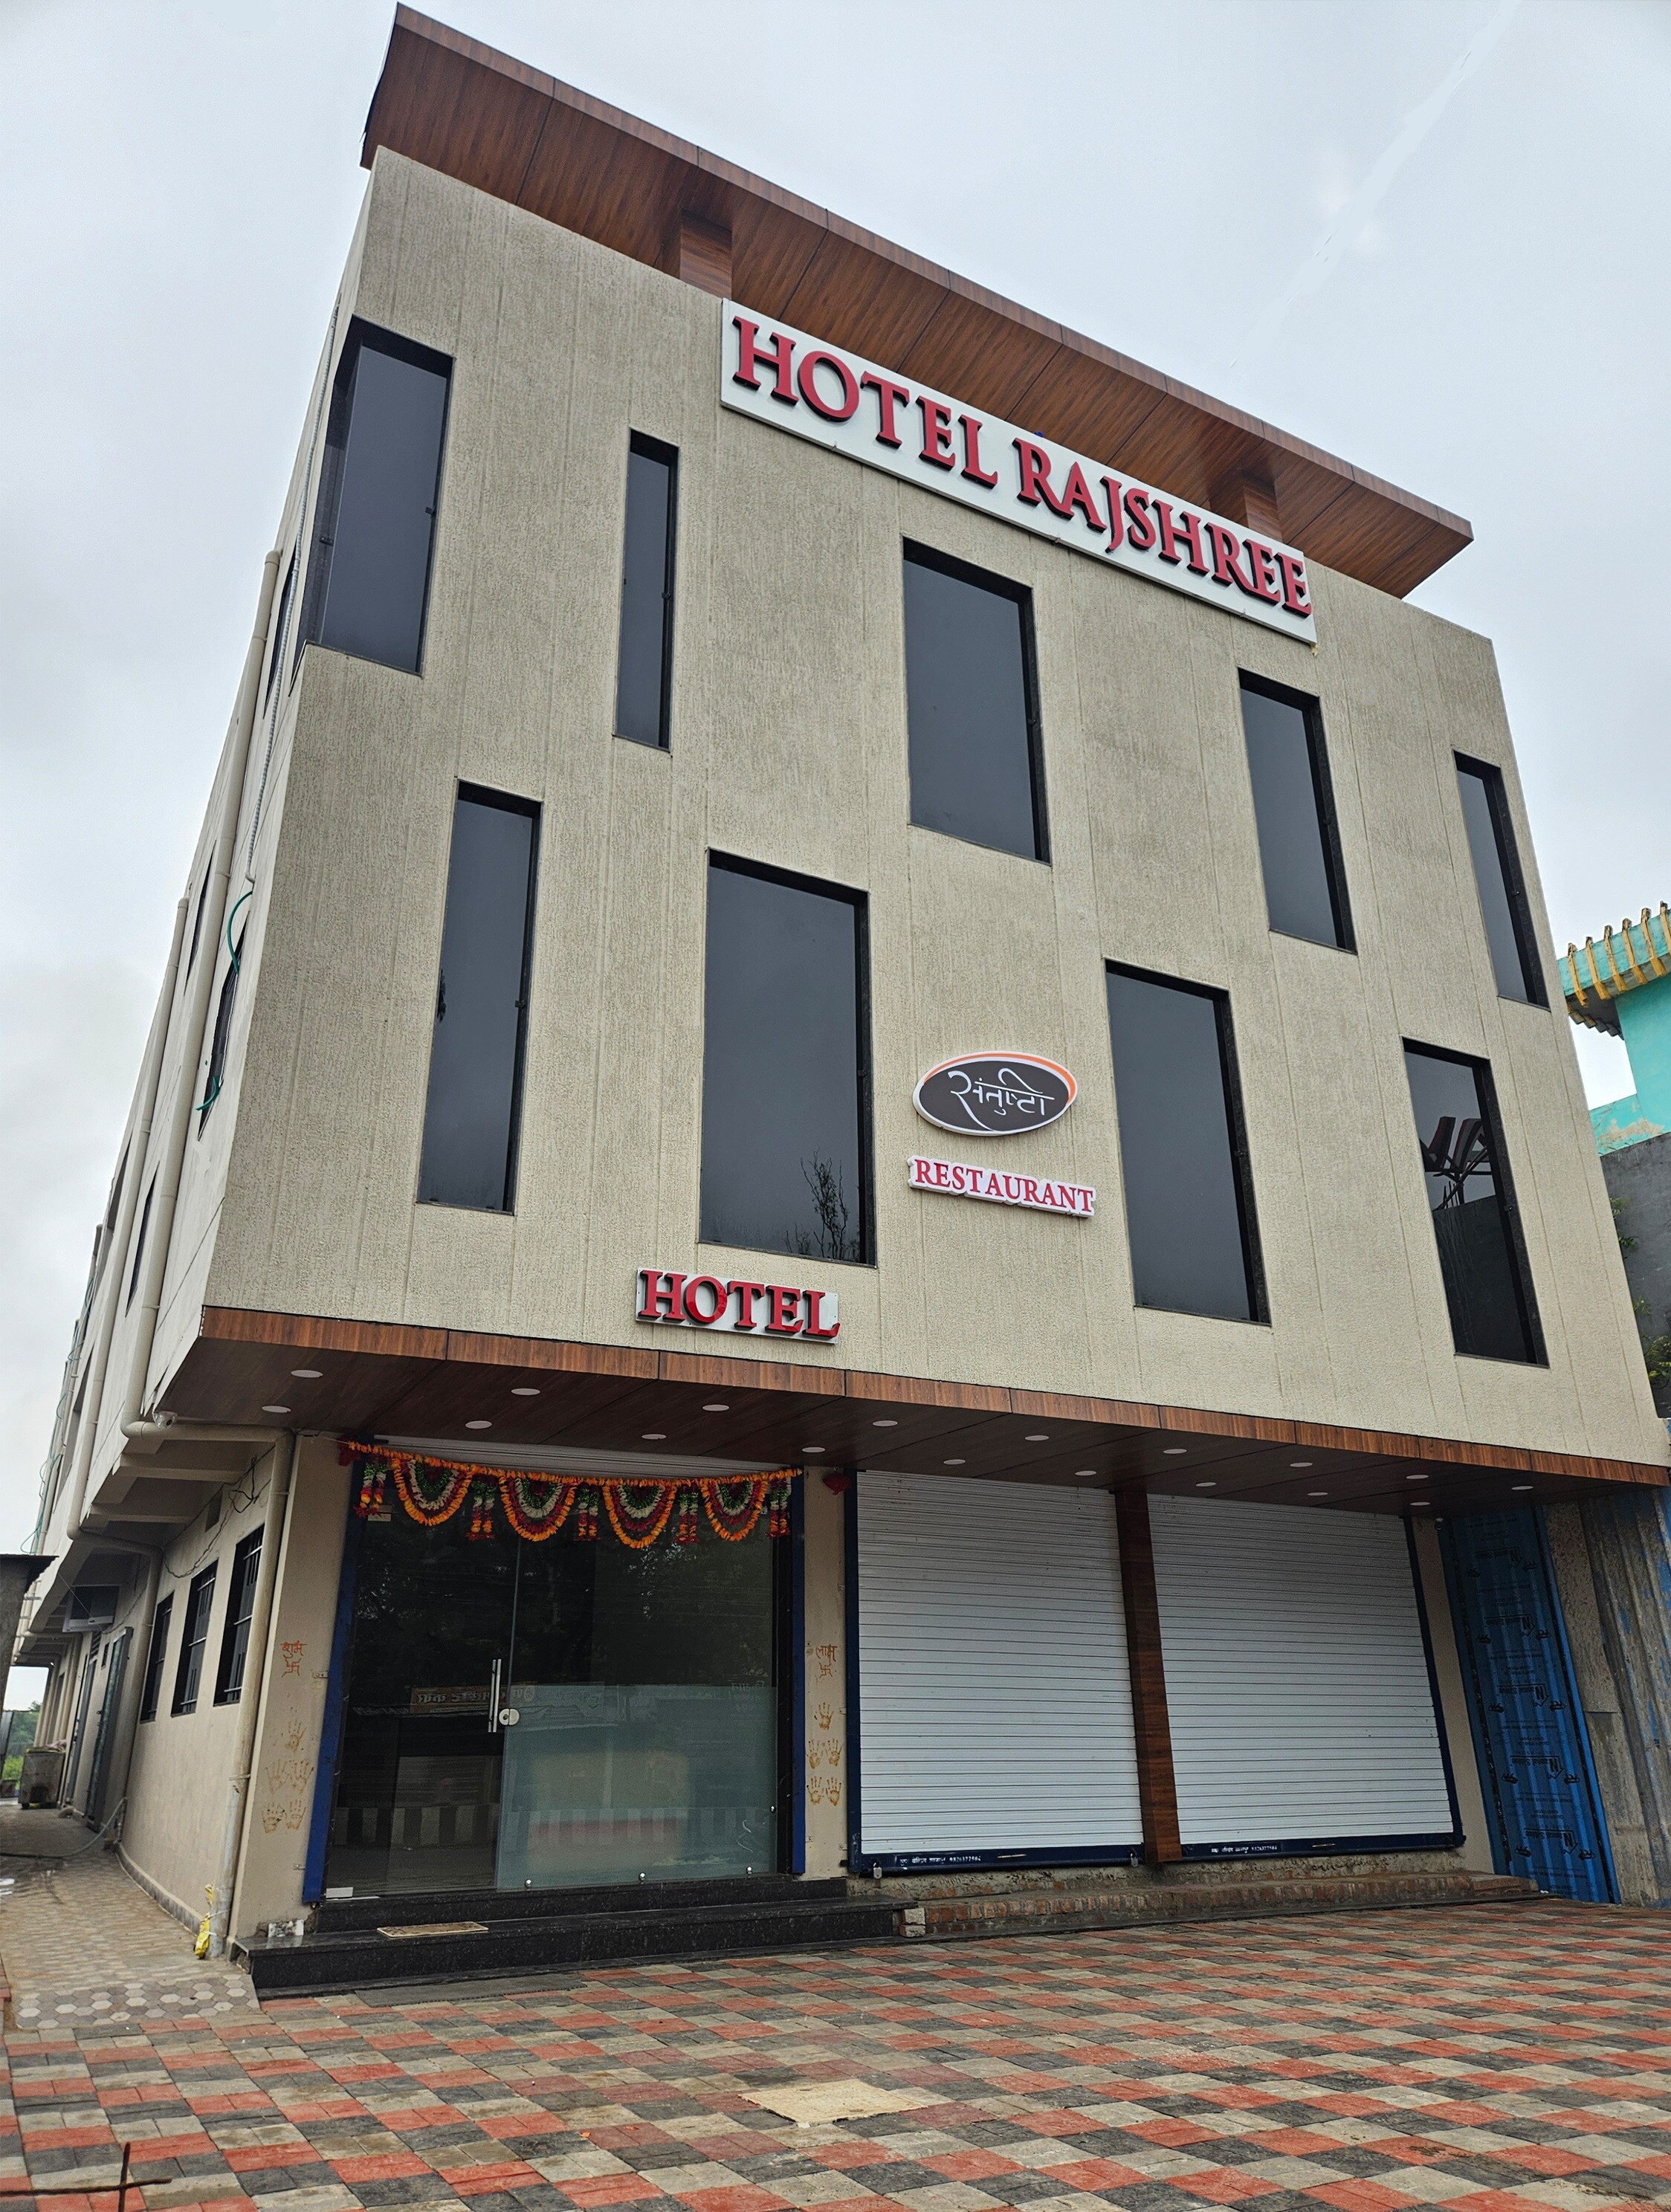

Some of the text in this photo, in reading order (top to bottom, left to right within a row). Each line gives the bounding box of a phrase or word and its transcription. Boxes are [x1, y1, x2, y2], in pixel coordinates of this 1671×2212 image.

[731, 315, 1313, 618] HOTEL RAJSHREE
[914, 1158, 1093, 1212] RESTAURANT
[638, 1269, 841, 1339] HOTEL
